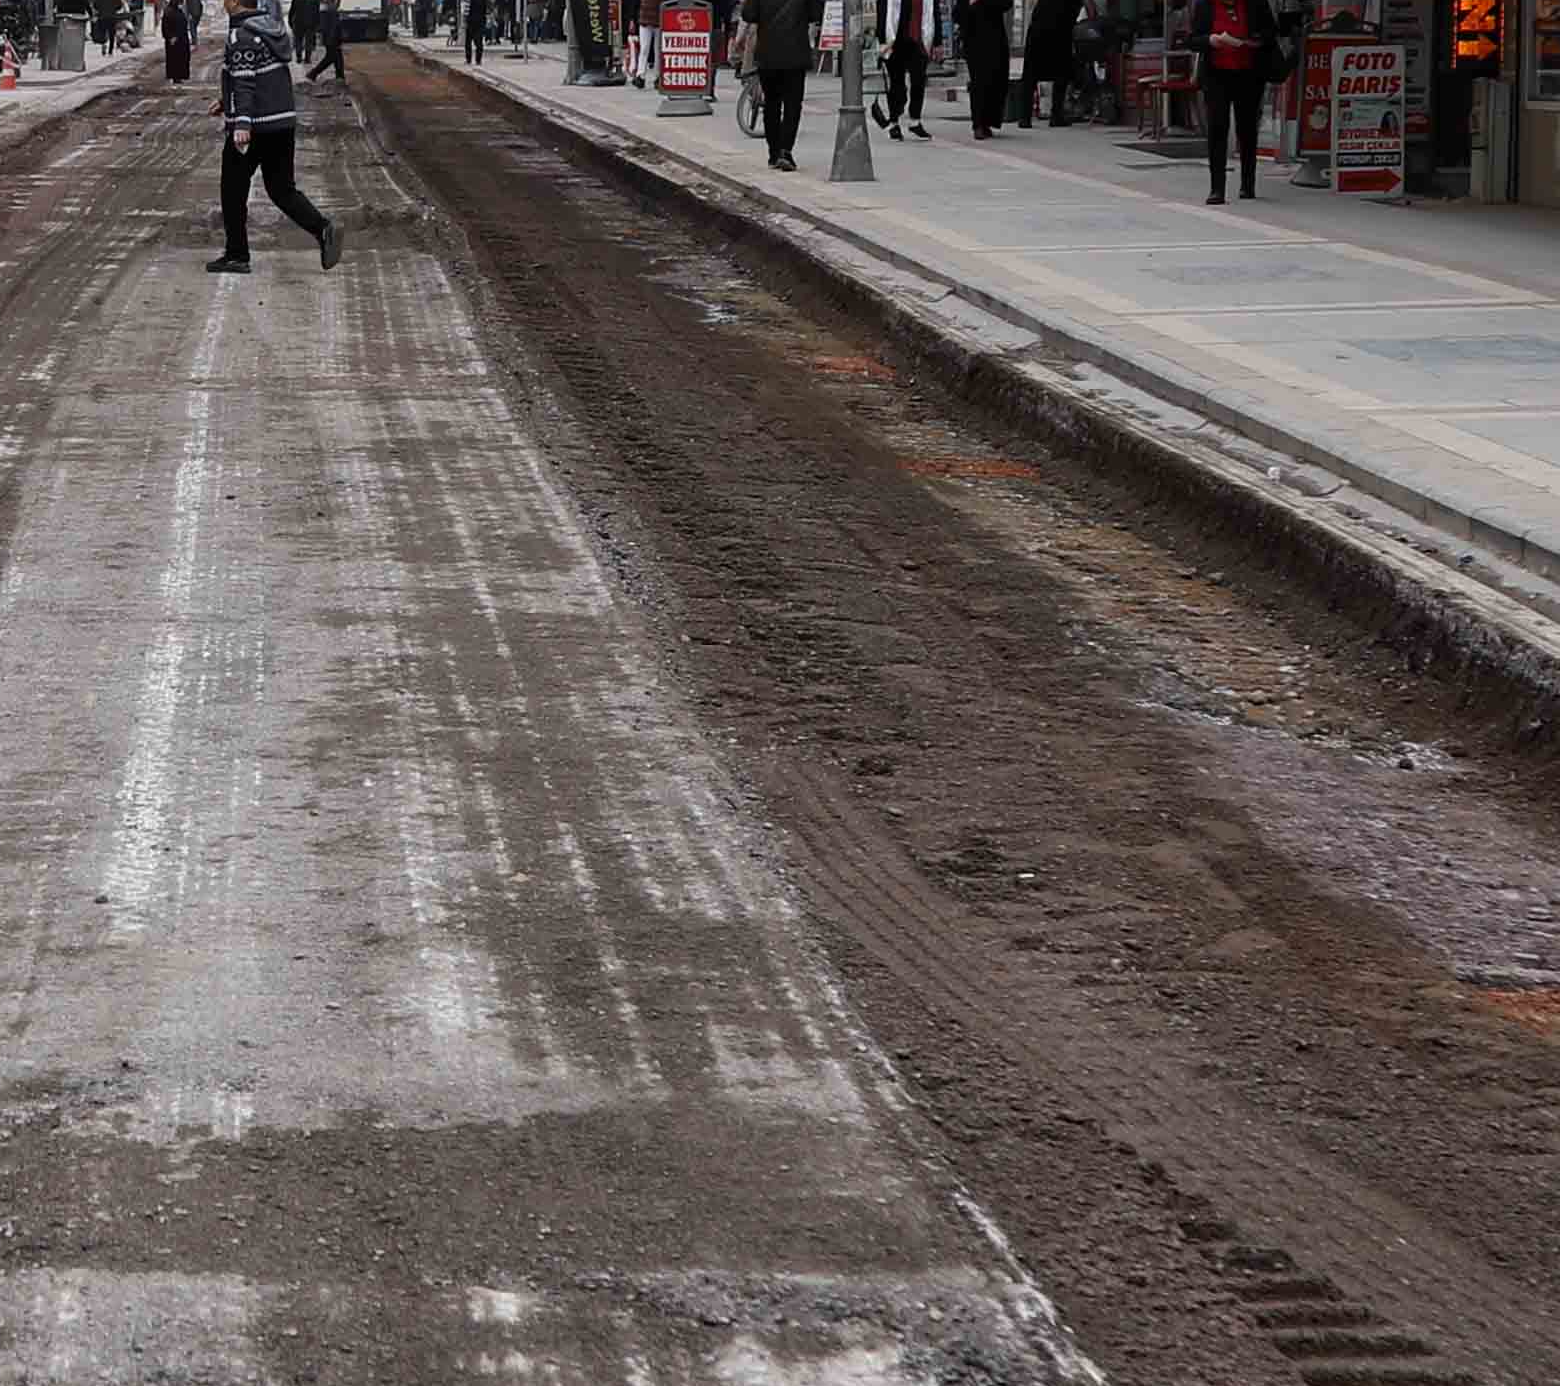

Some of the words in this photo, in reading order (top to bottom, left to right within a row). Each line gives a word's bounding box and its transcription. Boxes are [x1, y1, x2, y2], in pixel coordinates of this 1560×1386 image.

[664, 36, 708, 48] YERİNDE
[663, 54, 707, 69] TEKNİK
[1343, 52, 1396, 70] FOTO
[663, 72, 706, 86] SERVİS
[1337, 75, 1402, 98] BARIŞ
